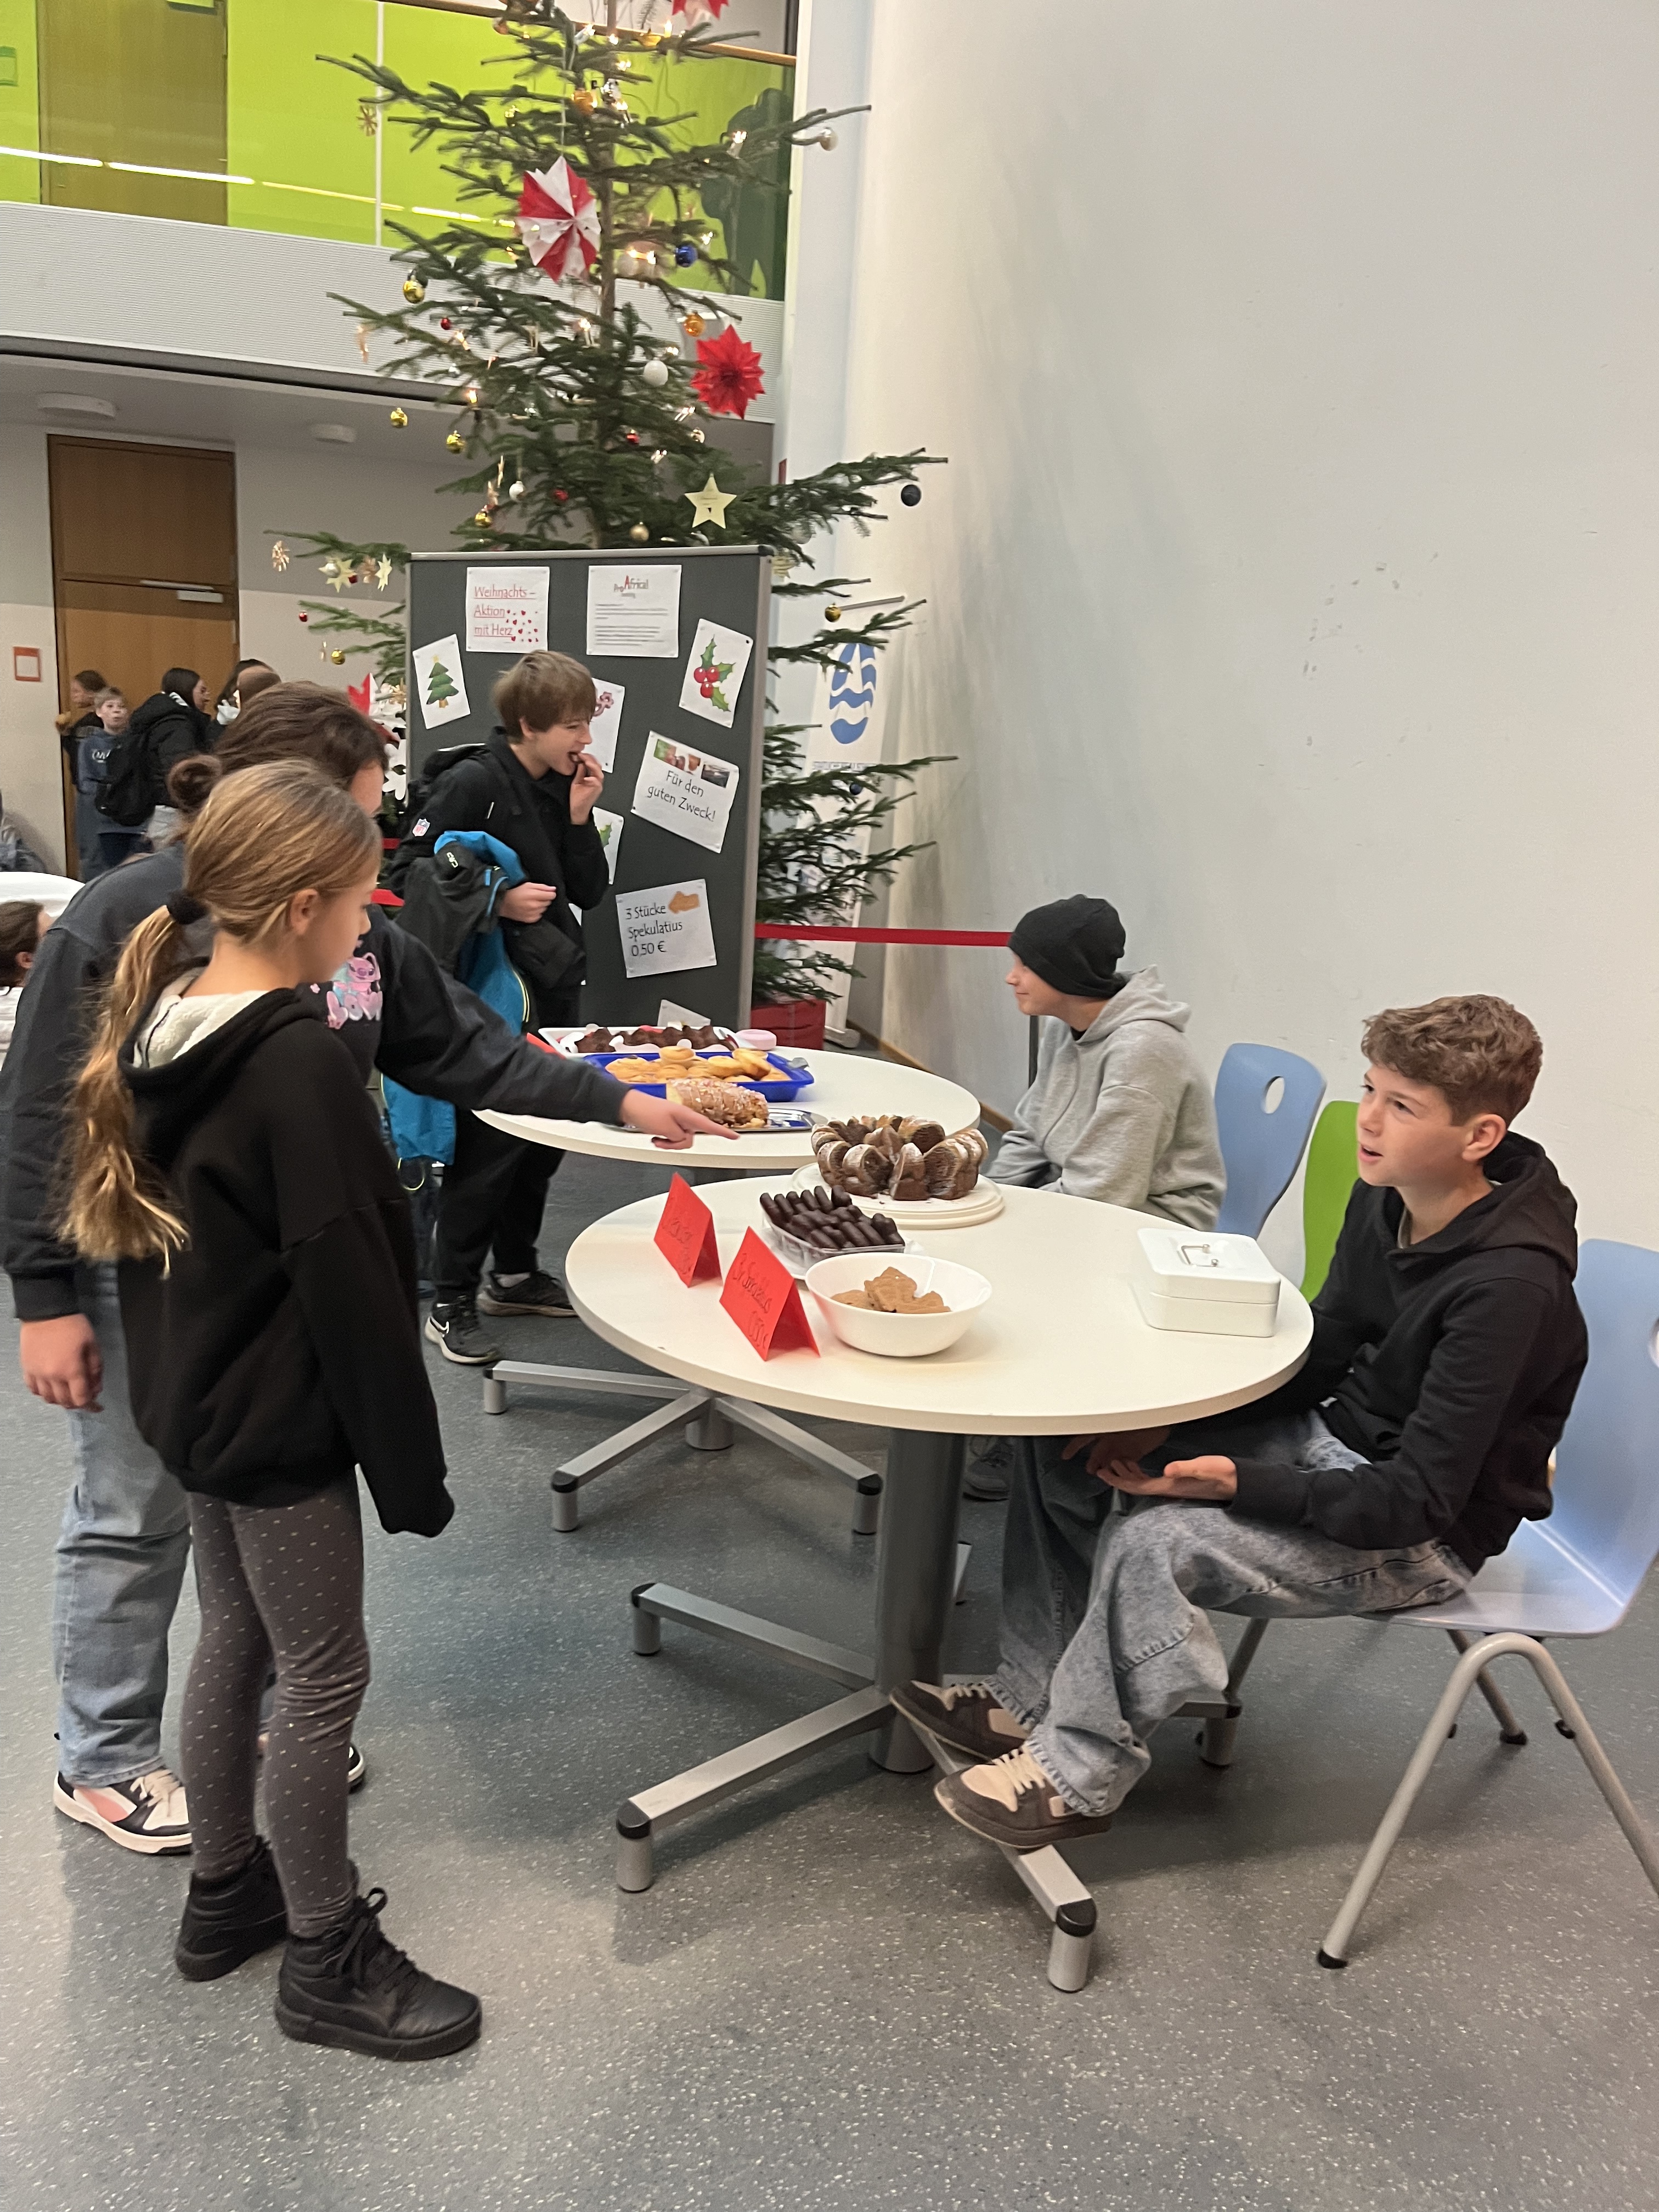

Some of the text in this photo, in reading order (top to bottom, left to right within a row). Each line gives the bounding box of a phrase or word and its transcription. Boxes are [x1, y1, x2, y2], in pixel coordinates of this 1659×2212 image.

[473, 603, 505, 617] Aktion
[475, 623, 513, 635] mit Herz
[666, 770, 704, 797] Für den
[646, 786, 716, 822] guten Zweck!
[625, 902, 666, 919] 3 Stücke
[628, 919, 683, 942] Spekulatius
[657, 940, 668, 952] €
